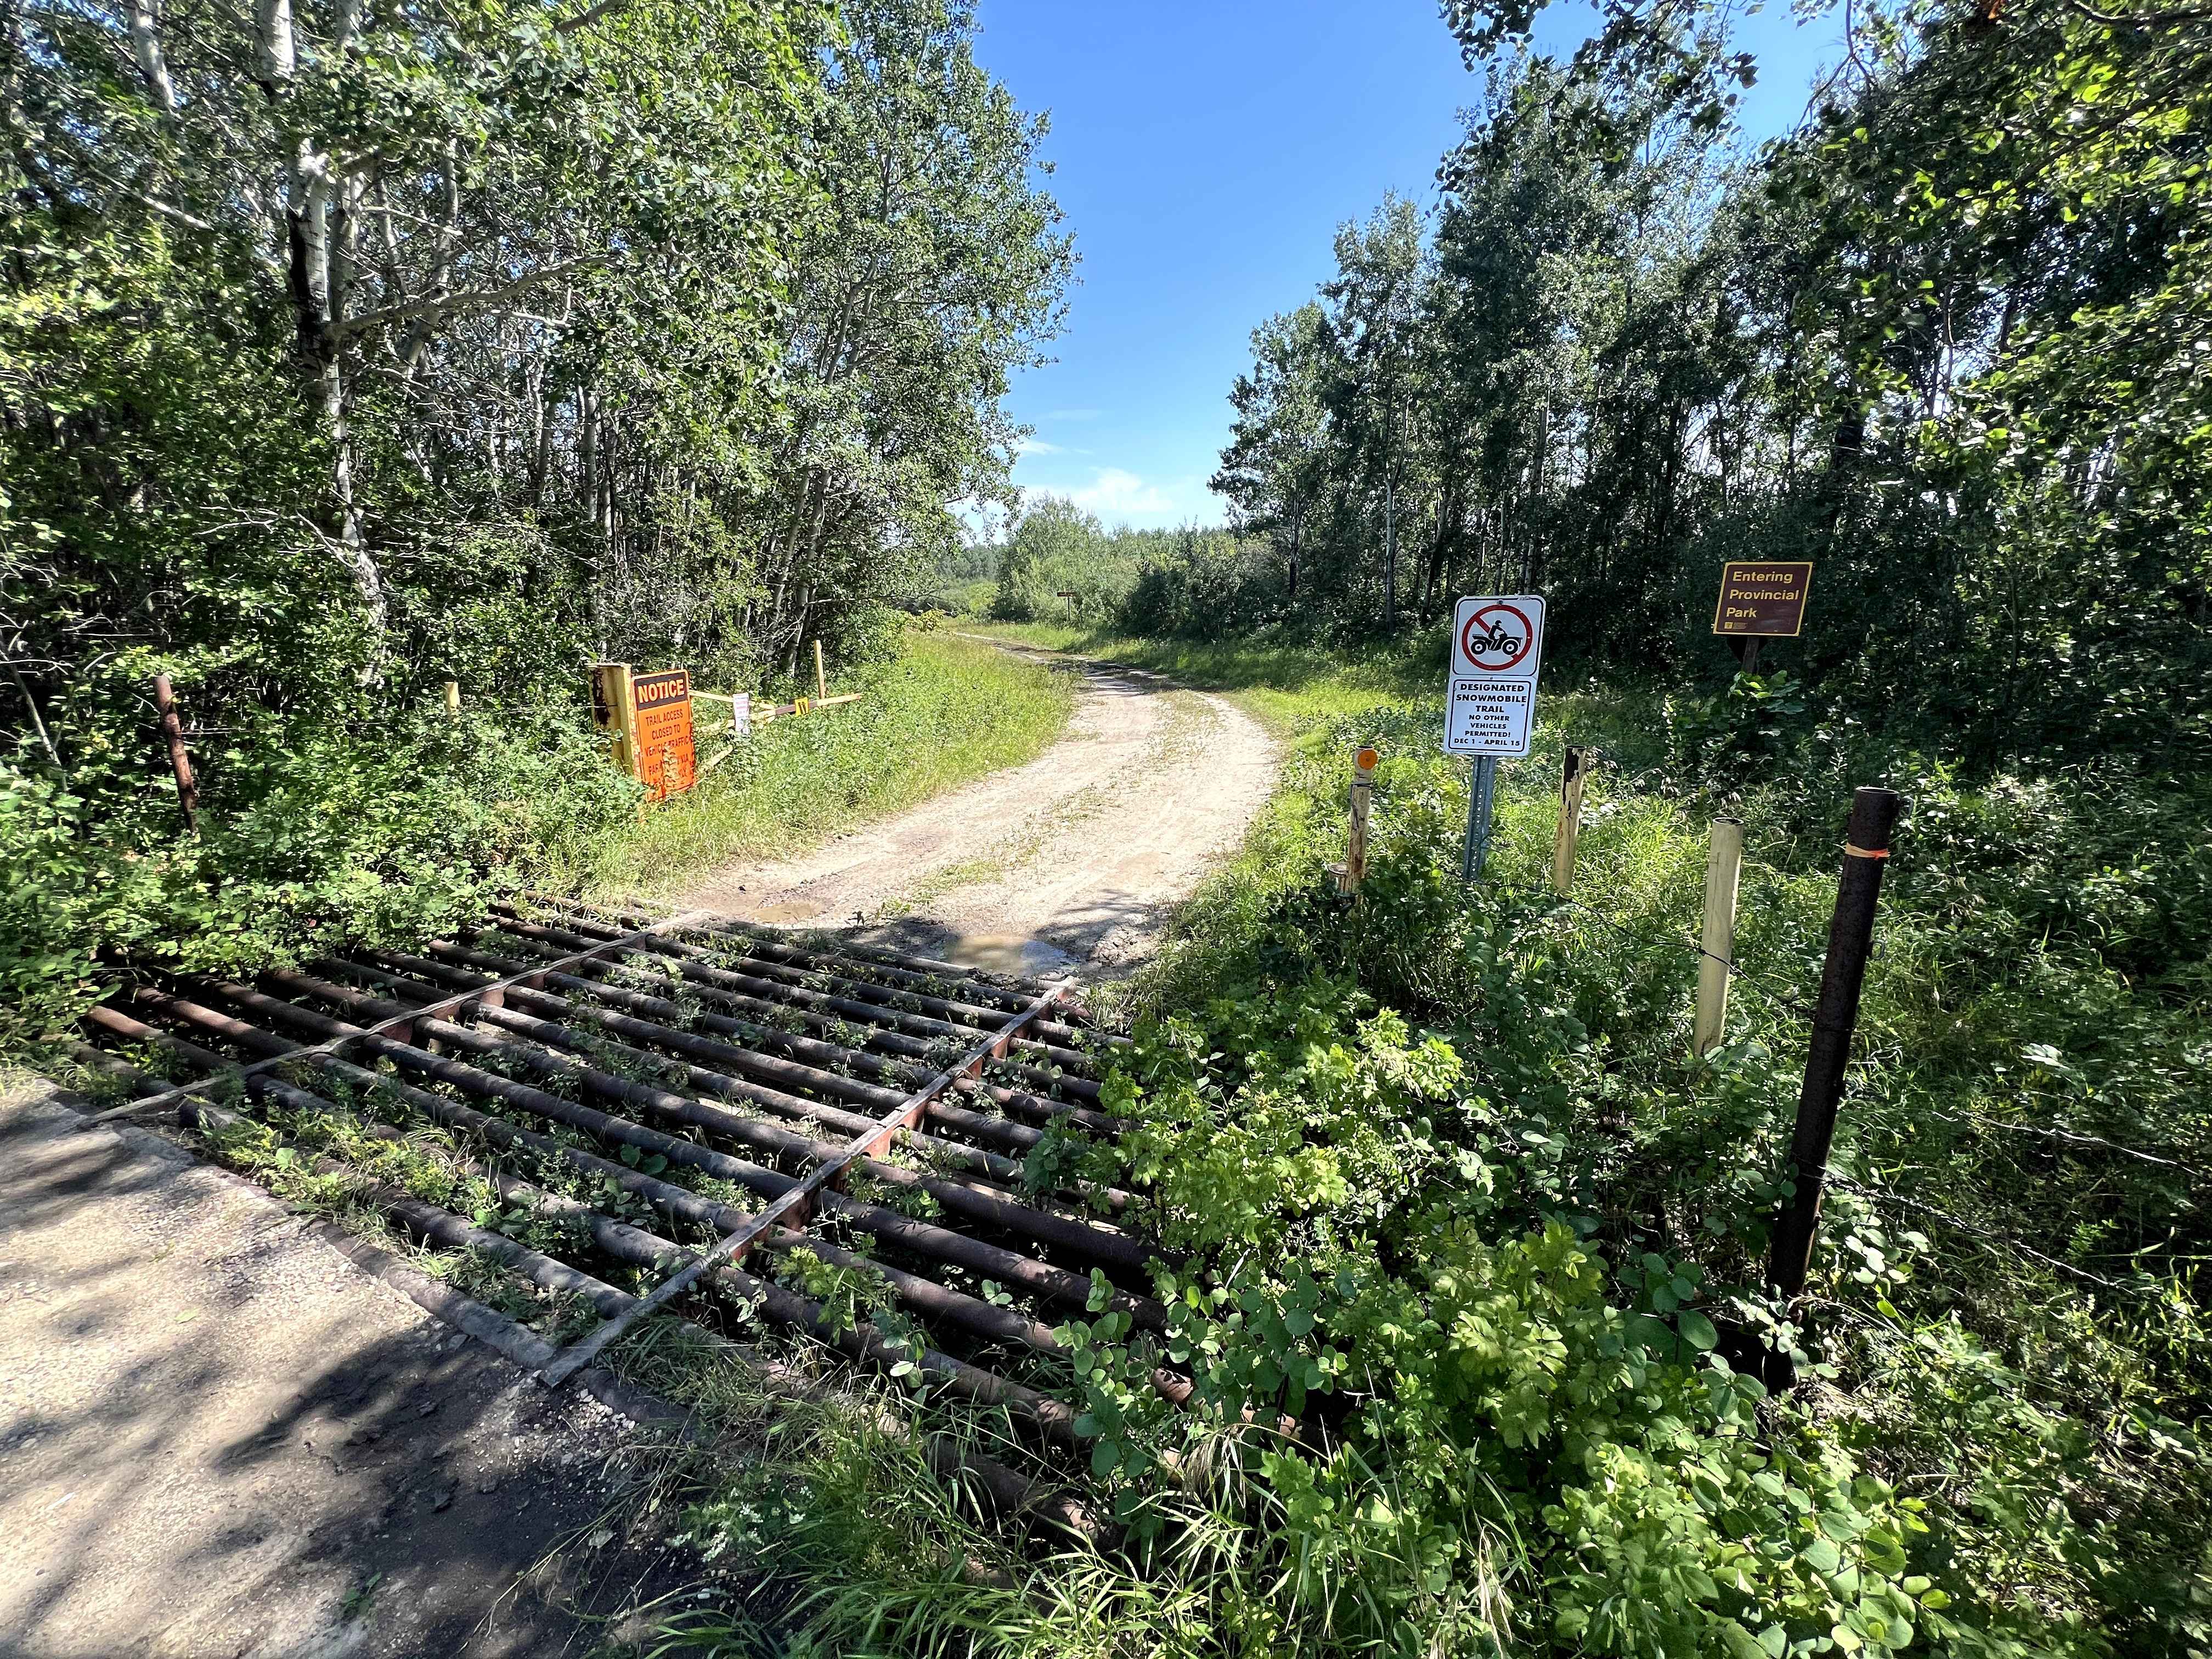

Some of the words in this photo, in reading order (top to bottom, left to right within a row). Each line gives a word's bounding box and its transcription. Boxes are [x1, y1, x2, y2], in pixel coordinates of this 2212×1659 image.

[1733, 571, 1793, 584] Entering
[1729, 589, 1799, 600] Provincial
[1726, 607, 1757, 618] Park
[637, 679, 685, 703] NOTICE
[1460, 684, 1525, 692] DESIGNATED
[1455, 694, 1527, 703] SNOWMOBILE
[646, 715, 662, 726] TRAIL
[663, 709, 684, 723] ACCESS
[652, 726, 672, 740] CLOSED
[673, 724, 680, 734] TO
